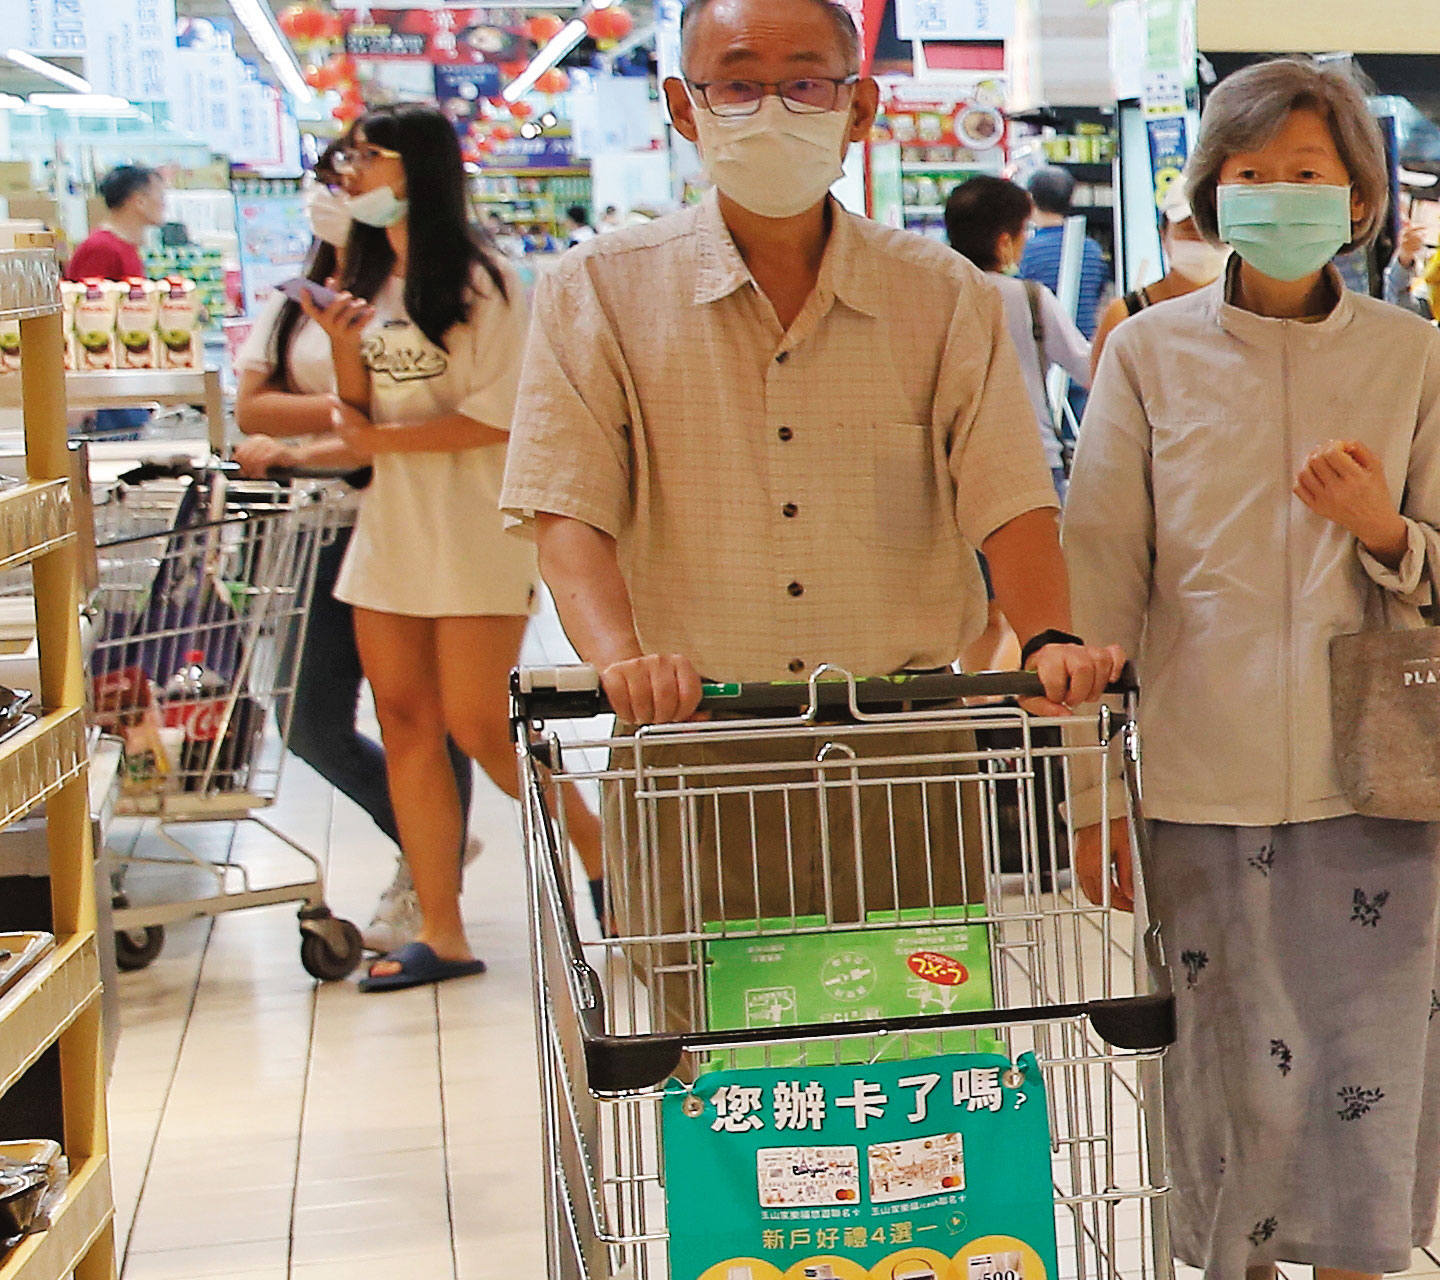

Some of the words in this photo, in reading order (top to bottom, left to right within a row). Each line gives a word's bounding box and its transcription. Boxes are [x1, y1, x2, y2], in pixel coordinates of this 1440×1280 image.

[710, 1065, 1027, 1134] 您辦卡了嗎?
[762, 1221, 938, 1250] 新戶好禮4選一
